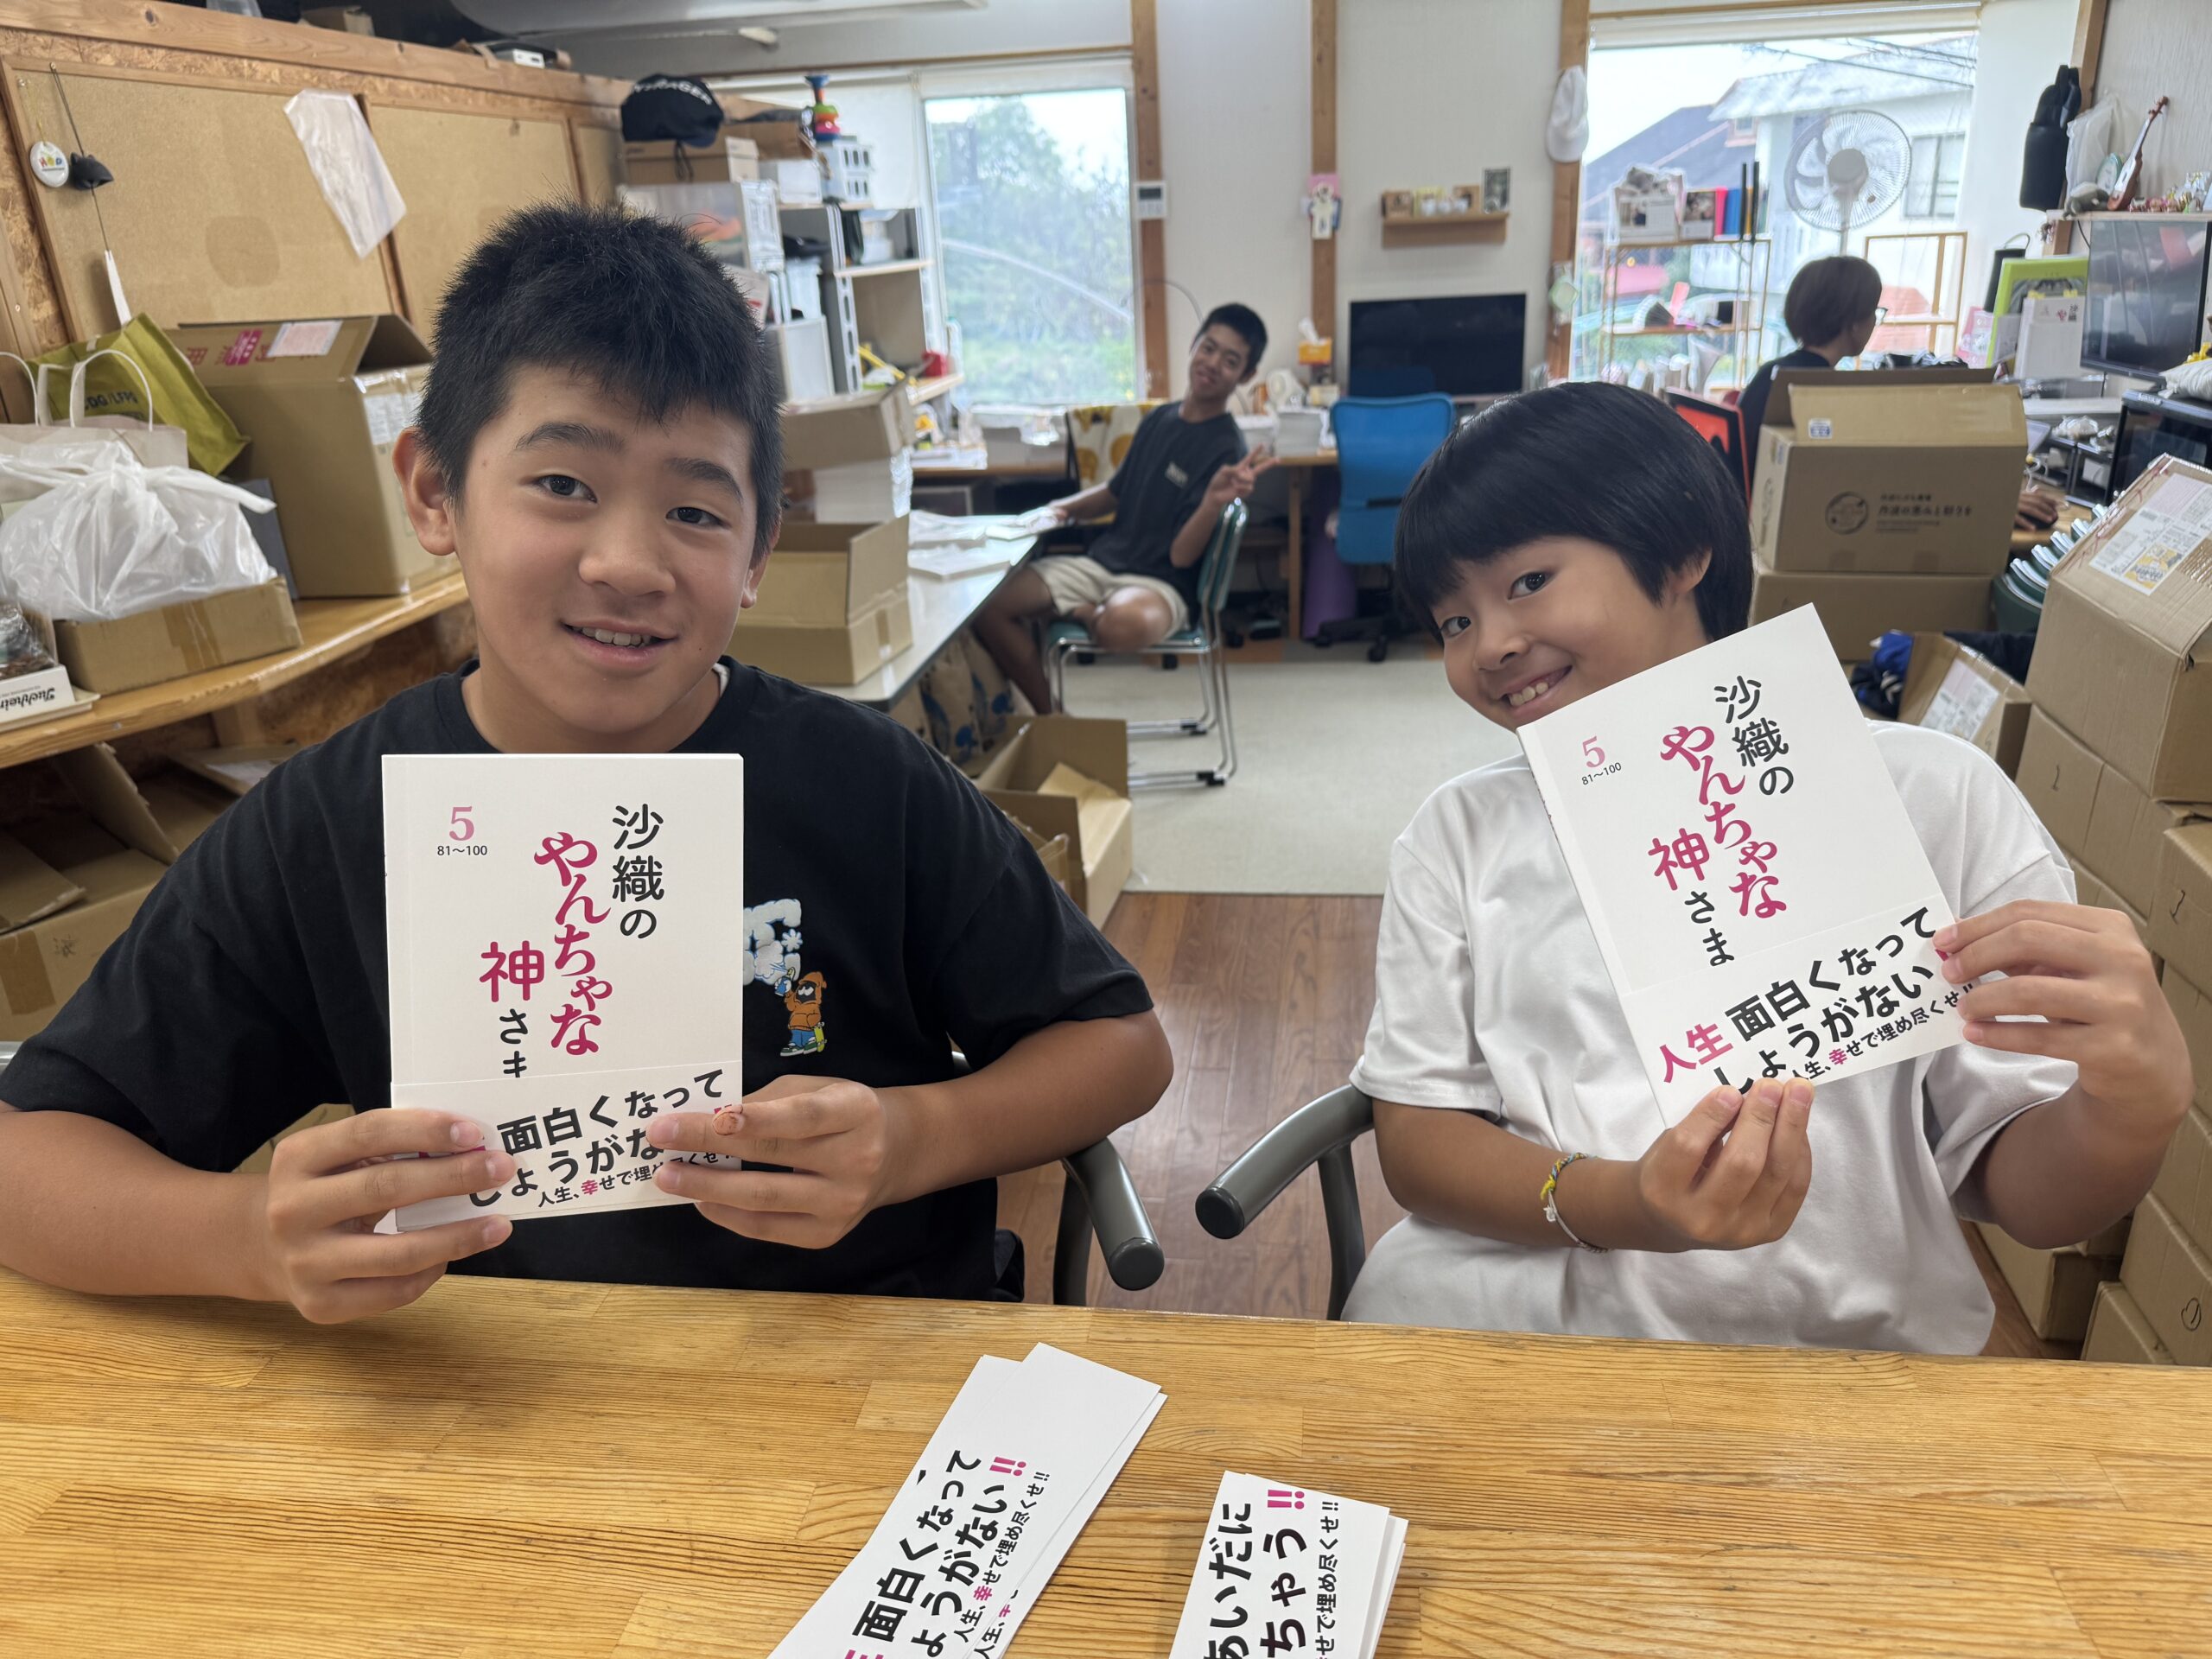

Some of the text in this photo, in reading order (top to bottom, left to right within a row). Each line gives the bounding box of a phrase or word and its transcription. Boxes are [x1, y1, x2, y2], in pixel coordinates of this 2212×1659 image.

[1582, 736, 1606, 769] 5
[1713, 675, 1794, 797] 沙織の
[448, 805, 476, 842] 5
[612, 804, 664, 939] 沙織の
[1660, 725, 1787, 919] やんちゃな
[534, 831, 613, 1056] やんちゃな
[1648, 828, 1735, 966] 神さま
[418, 1069, 723, 1158] 面白くなって
[1315, 1501, 1339, 1659] せで埋め尽くせ!!
